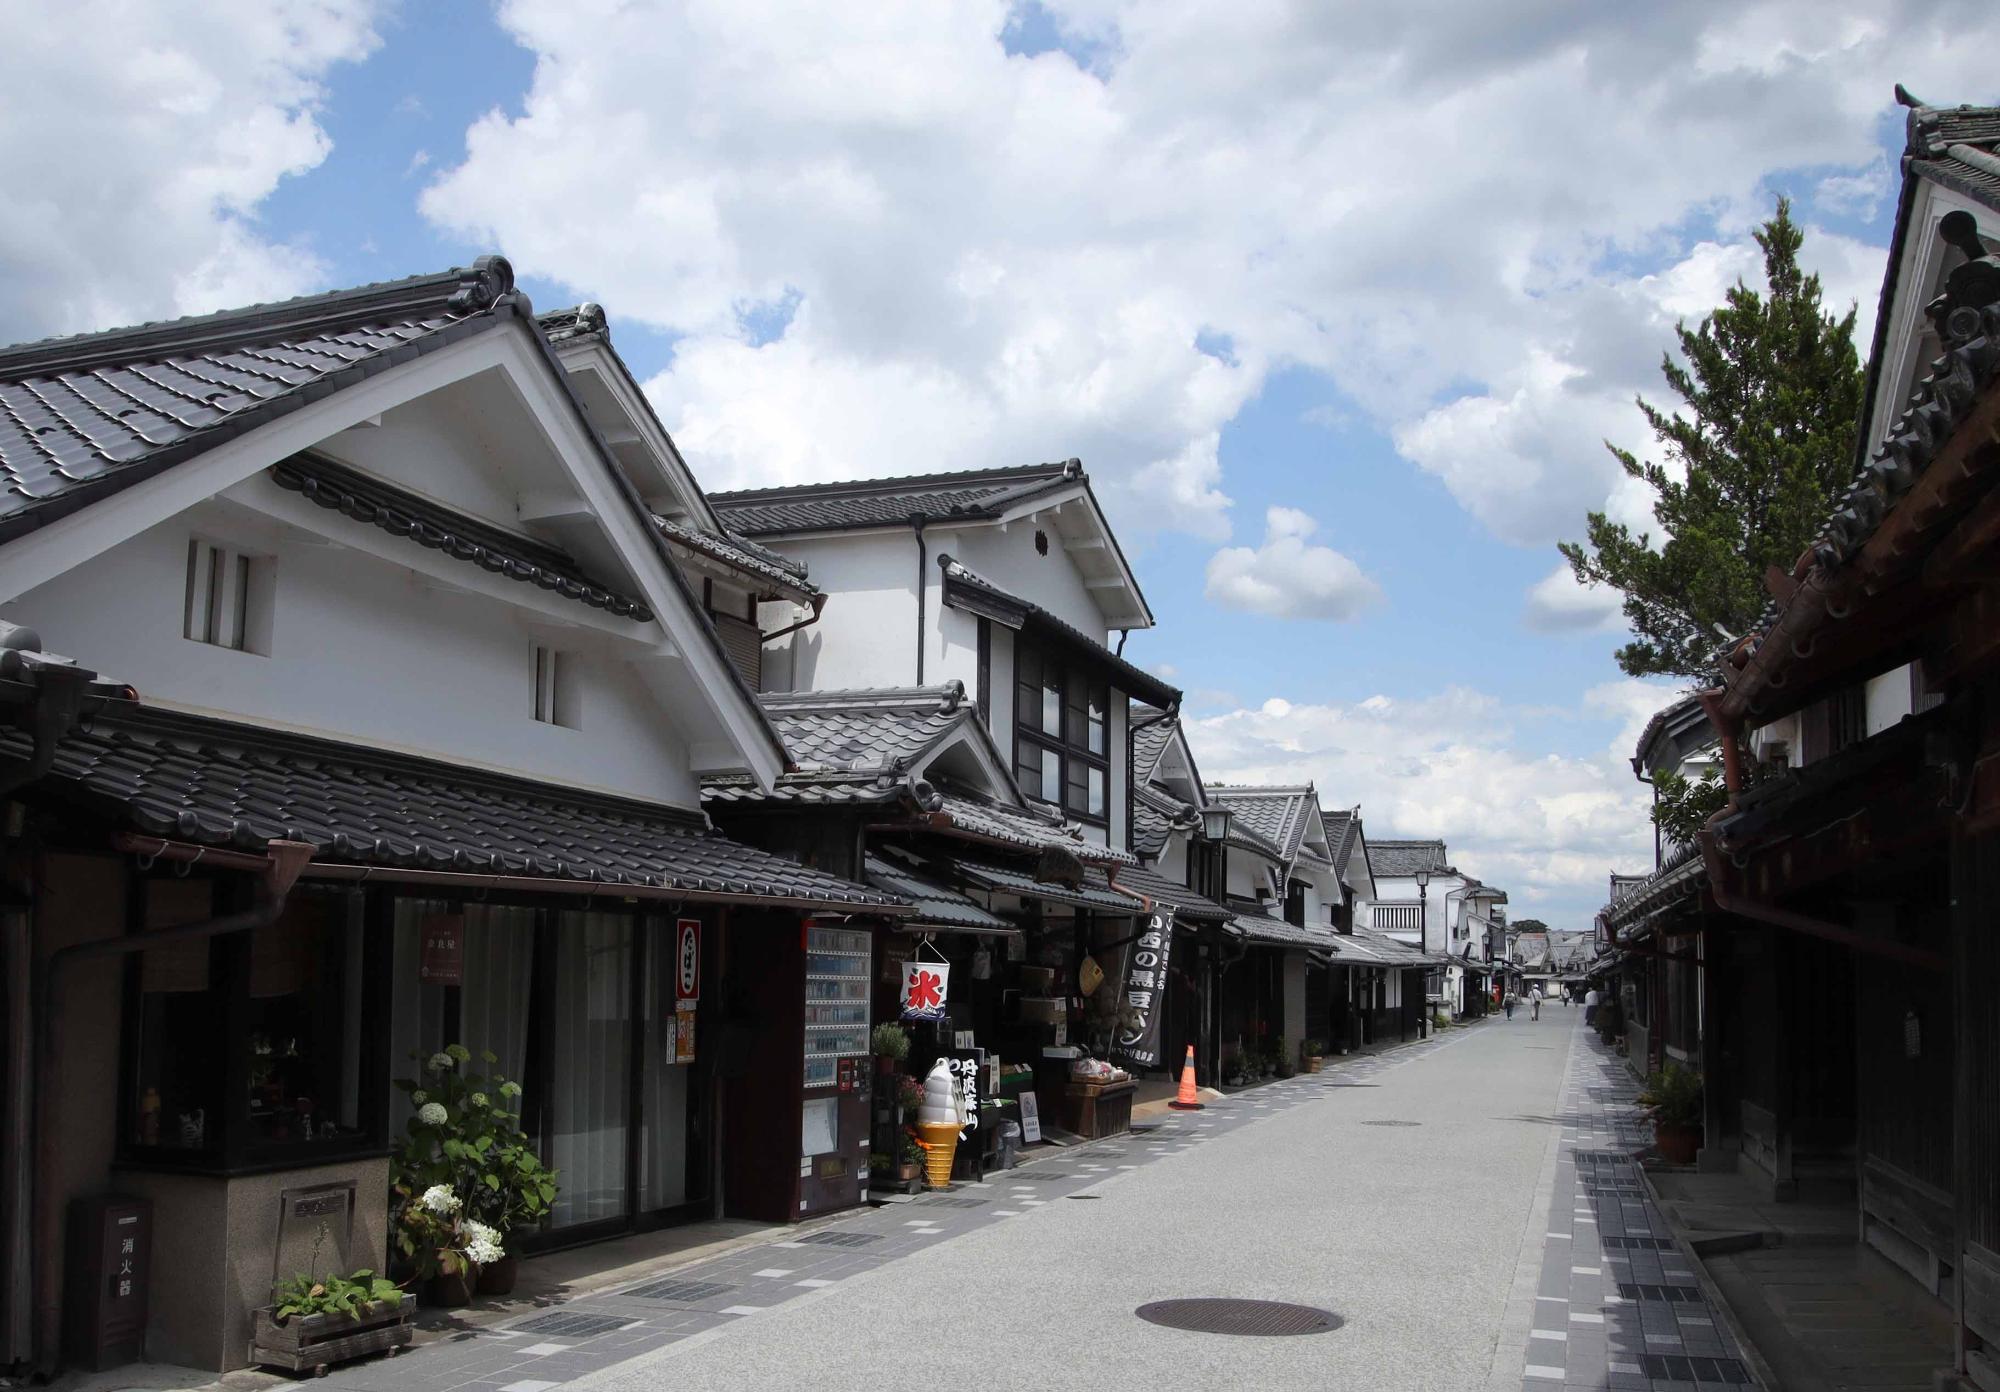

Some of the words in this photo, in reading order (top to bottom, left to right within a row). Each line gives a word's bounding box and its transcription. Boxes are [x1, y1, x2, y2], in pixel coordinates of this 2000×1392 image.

[684, 929, 694, 990] たばこ
[907, 970, 941, 1009] 氷
[120, 1238, 134, 1296] 消火器
